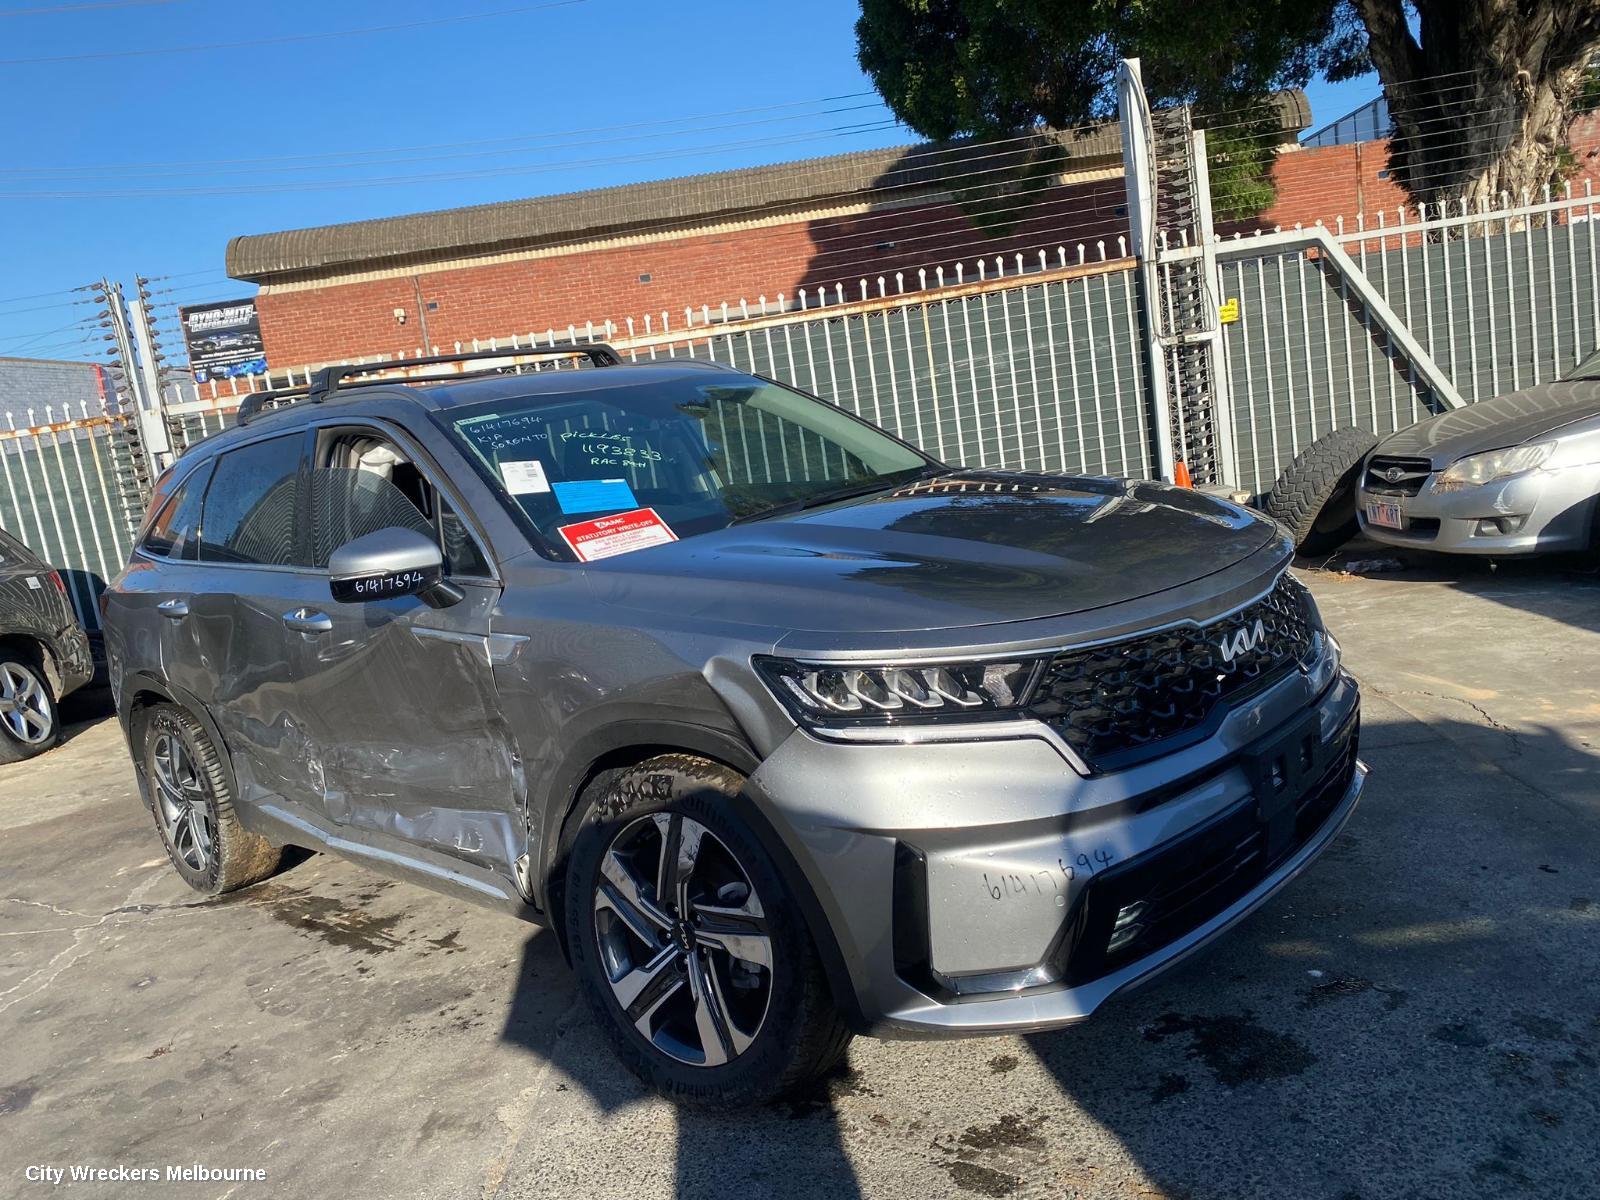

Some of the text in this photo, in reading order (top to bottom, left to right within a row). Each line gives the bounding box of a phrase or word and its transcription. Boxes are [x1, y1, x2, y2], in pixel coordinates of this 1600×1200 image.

[477, 433, 503, 444] KIA
[576, 519, 654, 542] STATUTORY WRITE-OFF
[355, 571, 424, 593] 61417694
[983, 849, 1113, 901] 61417694
